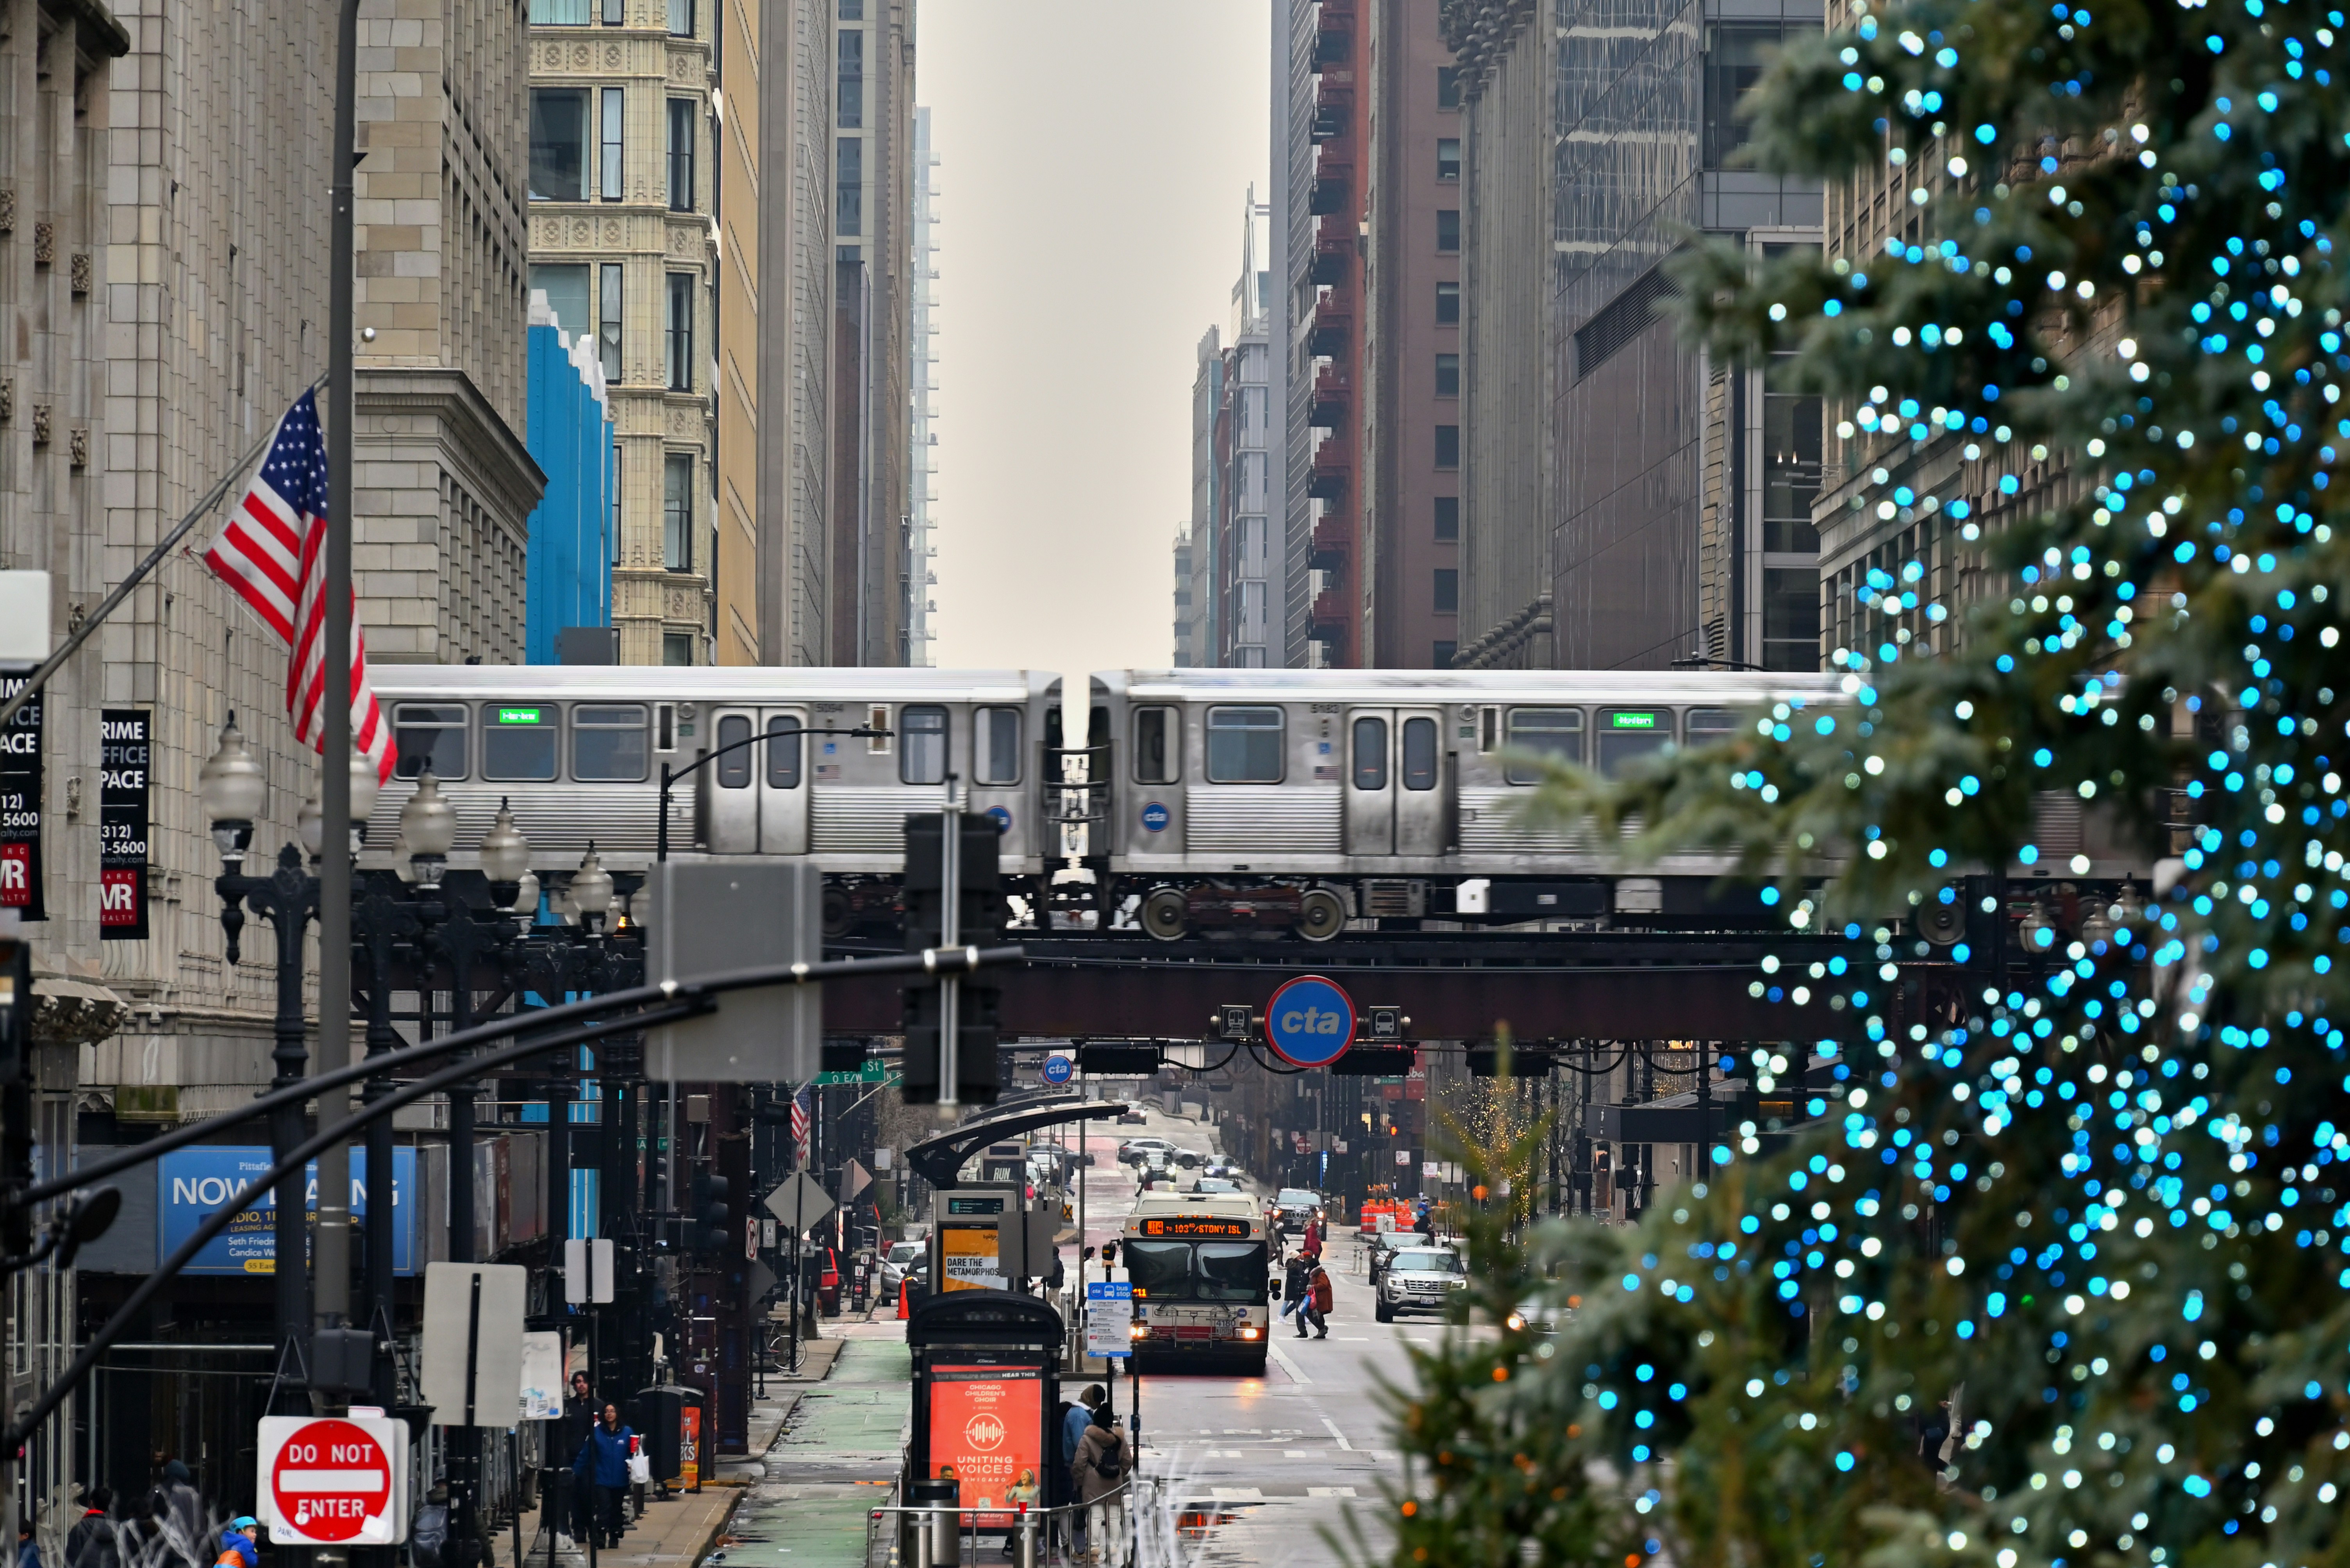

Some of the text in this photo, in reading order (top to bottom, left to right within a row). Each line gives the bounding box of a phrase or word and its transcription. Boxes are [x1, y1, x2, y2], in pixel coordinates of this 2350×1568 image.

[1282, 1006, 1340, 1034] cta
[868, 1061, 879, 1072] St
[1048, 1064, 1067, 1074] cta
[844, 1074, 862, 1082] E/W
[239, 1162, 271, 1170] Pittsfie
[993, 1167, 1011, 1180] RUN
[1148, 1221, 1163, 1234] J14
[1228, 1225, 1241, 1234] ISL
[228, 1237, 246, 1245] Seth
[229, 1248, 261, 1256] Candice
[947, 1258, 983, 1267] DARE THE
[289, 1444, 373, 1463] DO NOT
[957, 1465, 1013, 1474] VOICES
[298, 1499, 365, 1518] ENTER
